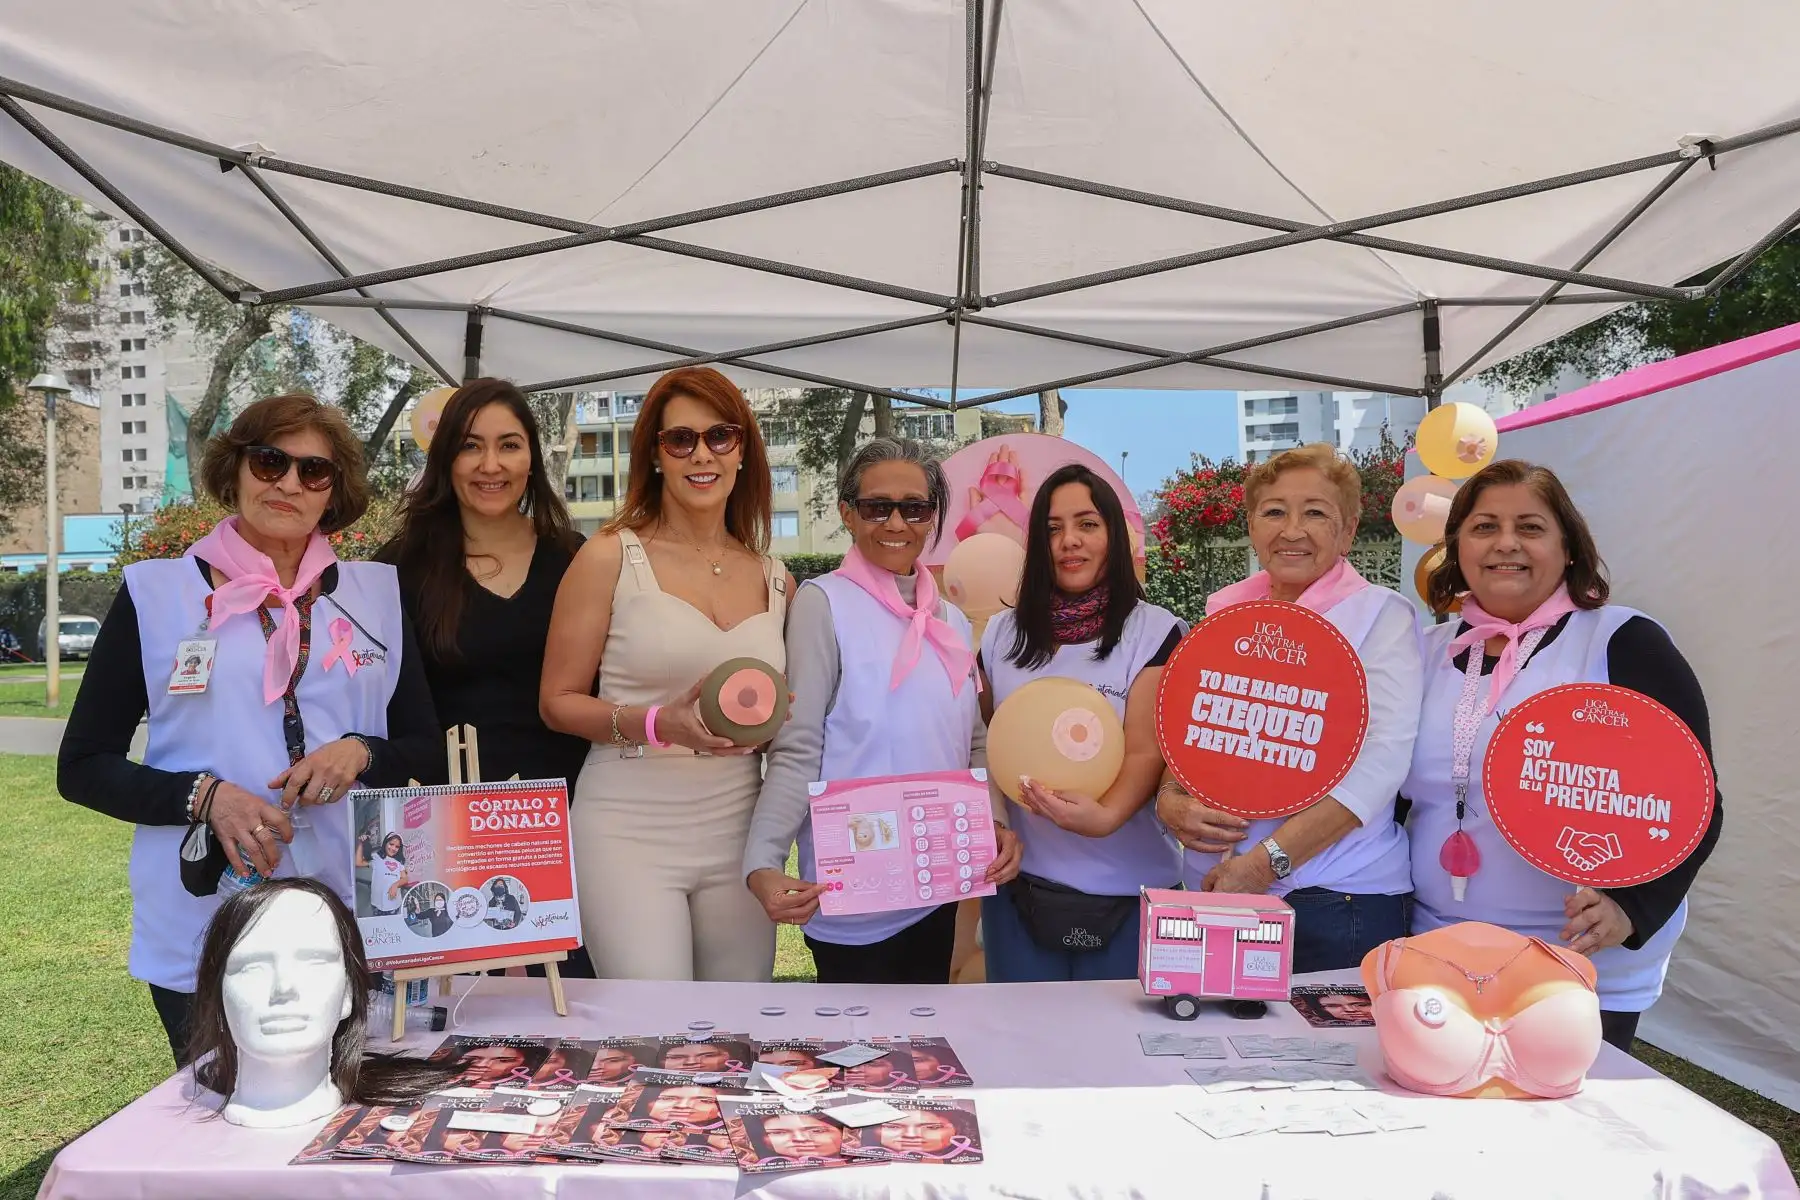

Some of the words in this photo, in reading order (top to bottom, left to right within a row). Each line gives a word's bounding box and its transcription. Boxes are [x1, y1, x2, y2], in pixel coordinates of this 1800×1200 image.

[1254, 621, 1283, 637] LIGA
[1252, 634, 1296, 649] CONTRA
[1199, 669, 1221, 690] YO
[1221, 674, 1250, 696] ME
[1249, 679, 1299, 706] HAGO
[1301, 687, 1328, 711] UN
[1584, 706, 1619, 717] CONTRA
[1585, 699, 1608, 709] LIGA
[1191, 692, 1324, 746] CHEQUEO
[1183, 724, 1317, 773] PREVENTIVO
[1522, 738, 1554, 759] SOY
[1520, 757, 1620, 792] ACTIVISTA
[548, 797, 559, 809] Y
[1519, 779, 1531, 791] DE
[1531, 780, 1542, 792] LA
[1545, 782, 1671, 823] PREVENCIÓN
